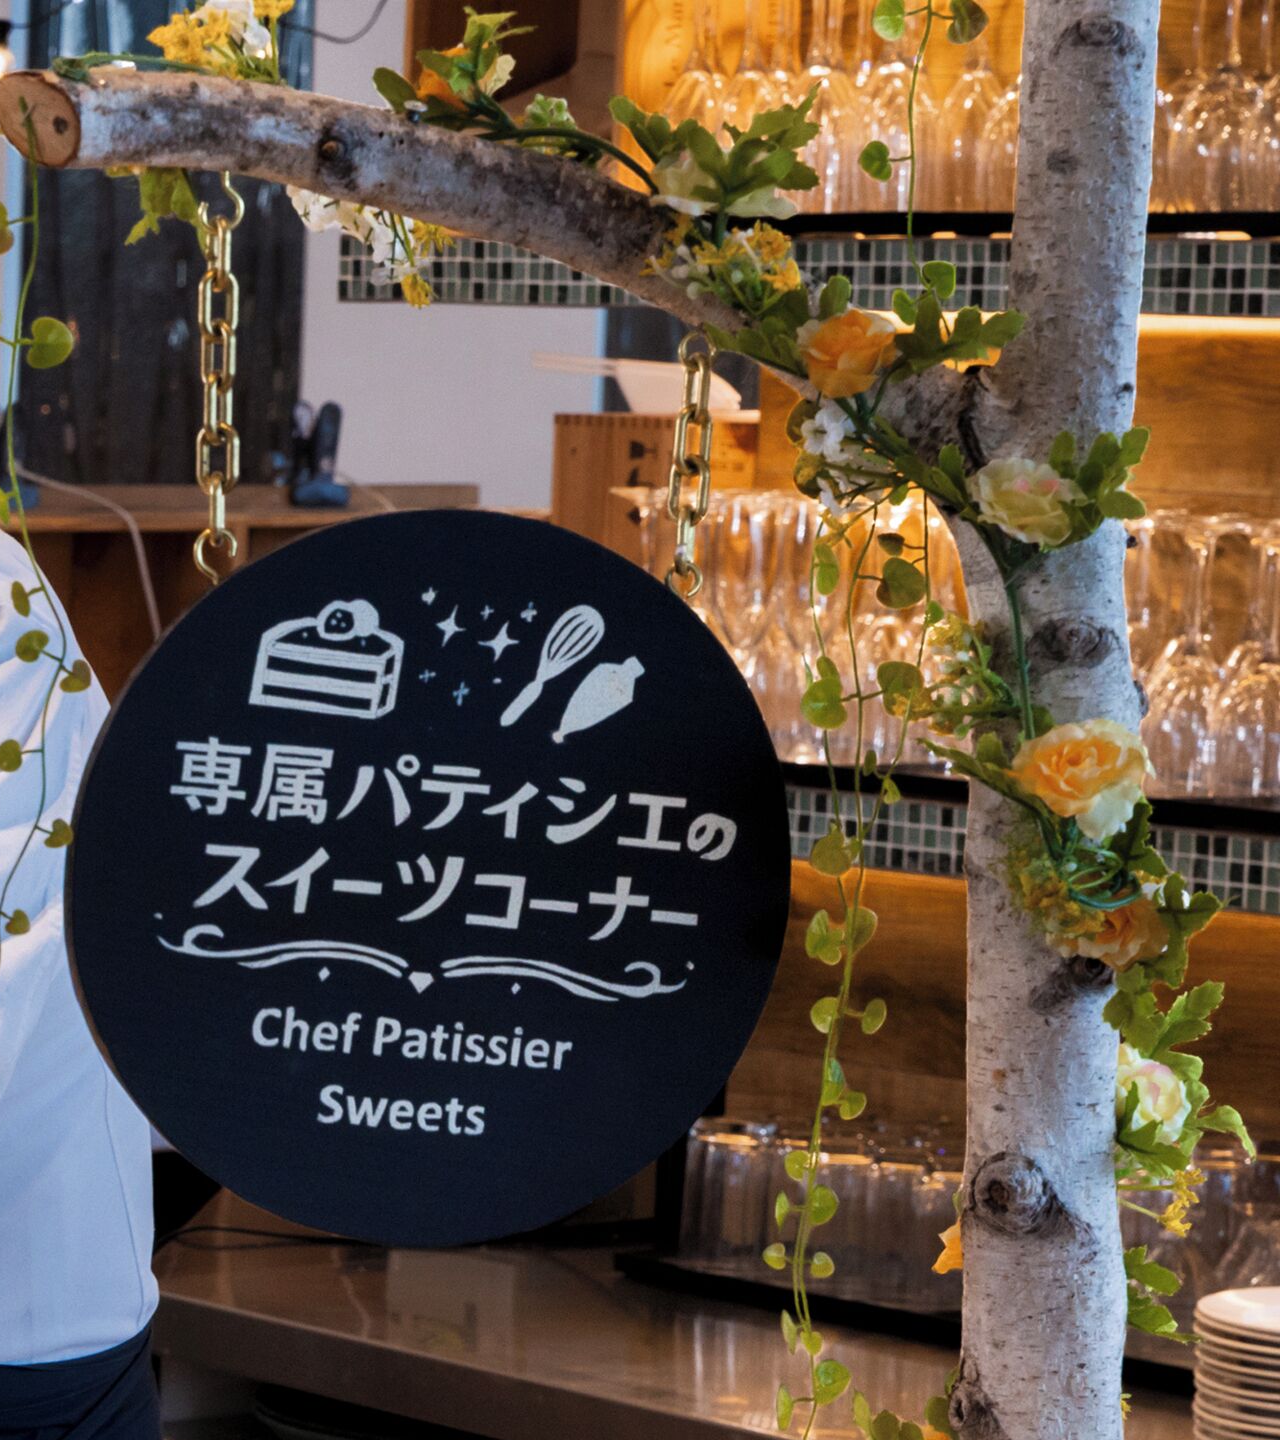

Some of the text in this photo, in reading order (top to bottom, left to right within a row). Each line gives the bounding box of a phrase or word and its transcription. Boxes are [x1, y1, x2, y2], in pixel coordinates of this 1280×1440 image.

[170, 736, 738, 863] 専属パティシエの
[193, 842, 700, 942] スイーツコーナー
[251, 1007, 574, 1071] Chef Patissier
[317, 1084, 487, 1136] Sweets
